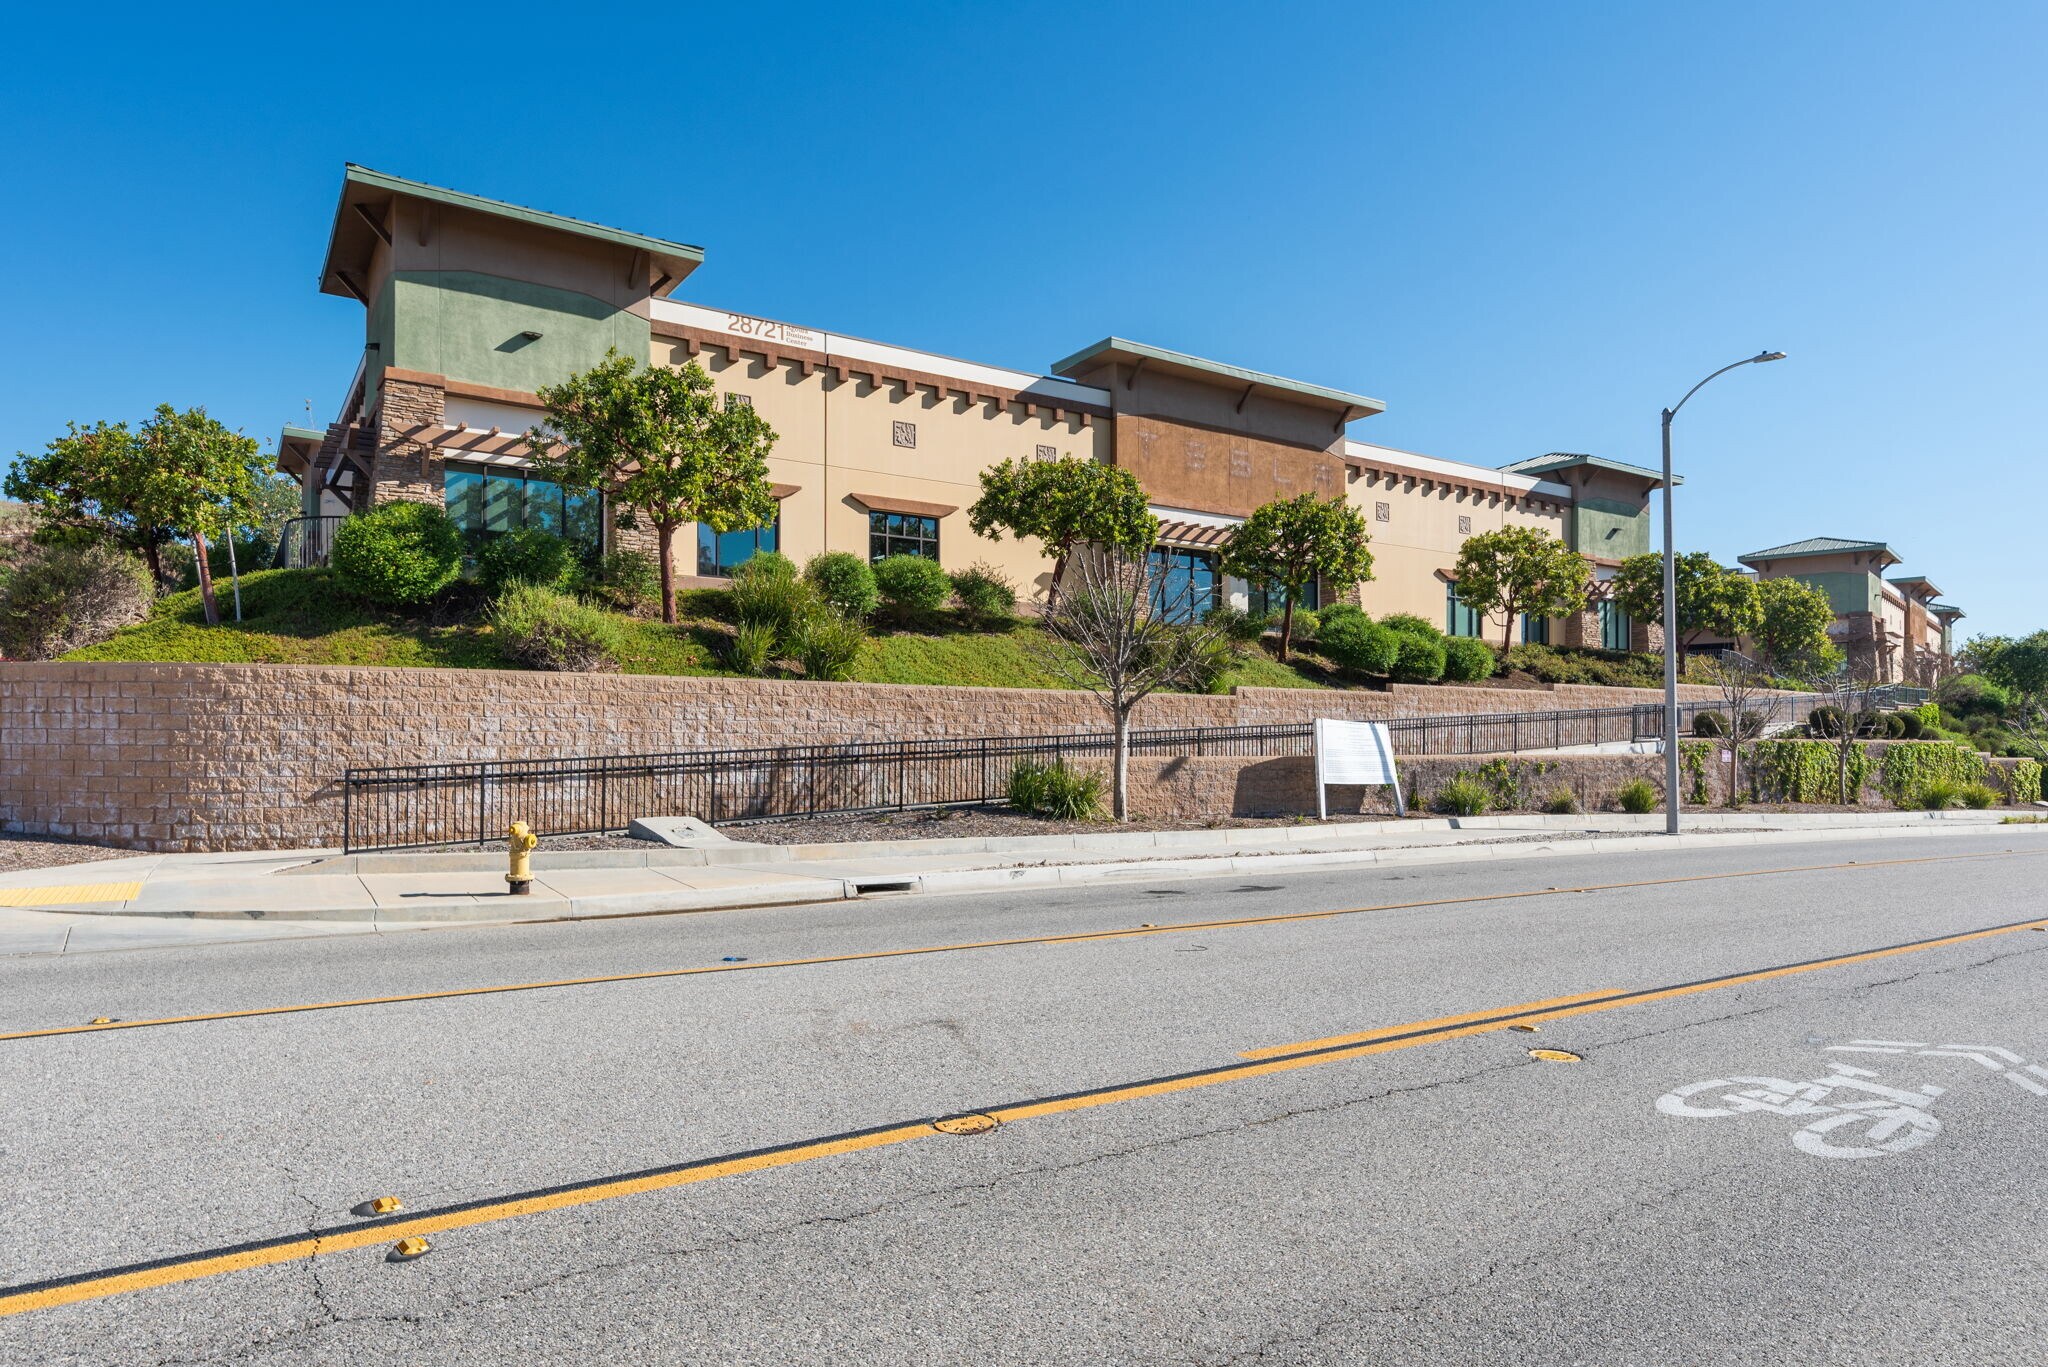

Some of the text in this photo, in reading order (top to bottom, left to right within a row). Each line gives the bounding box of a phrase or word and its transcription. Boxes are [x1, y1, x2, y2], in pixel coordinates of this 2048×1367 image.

[728, 314, 784, 340] 28721
[786, 331, 813, 342] Business
[786, 337, 807, 347] Center
